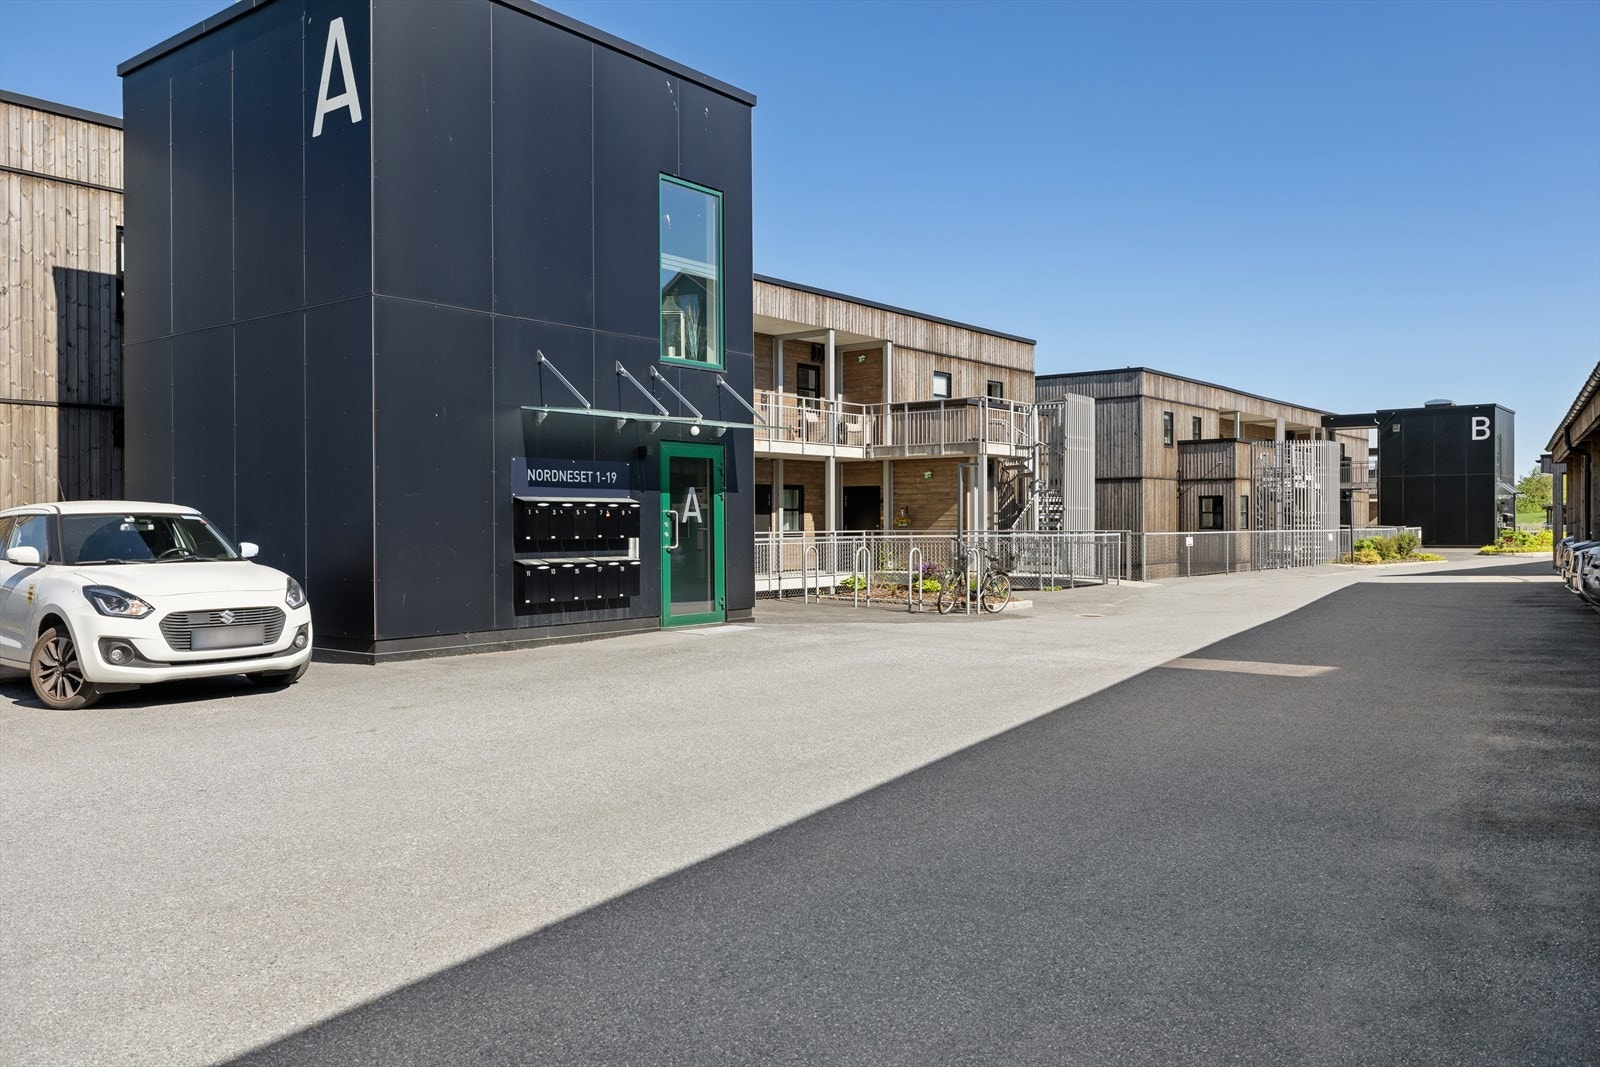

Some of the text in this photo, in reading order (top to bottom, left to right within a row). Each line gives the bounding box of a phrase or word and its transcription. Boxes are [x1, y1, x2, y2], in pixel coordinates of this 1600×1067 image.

[312, 16, 363, 138] A
[1471, 416, 1491, 441] B
[527, 468, 617, 484] NORDNESET 1-19
[682, 486, 703, 523] A
